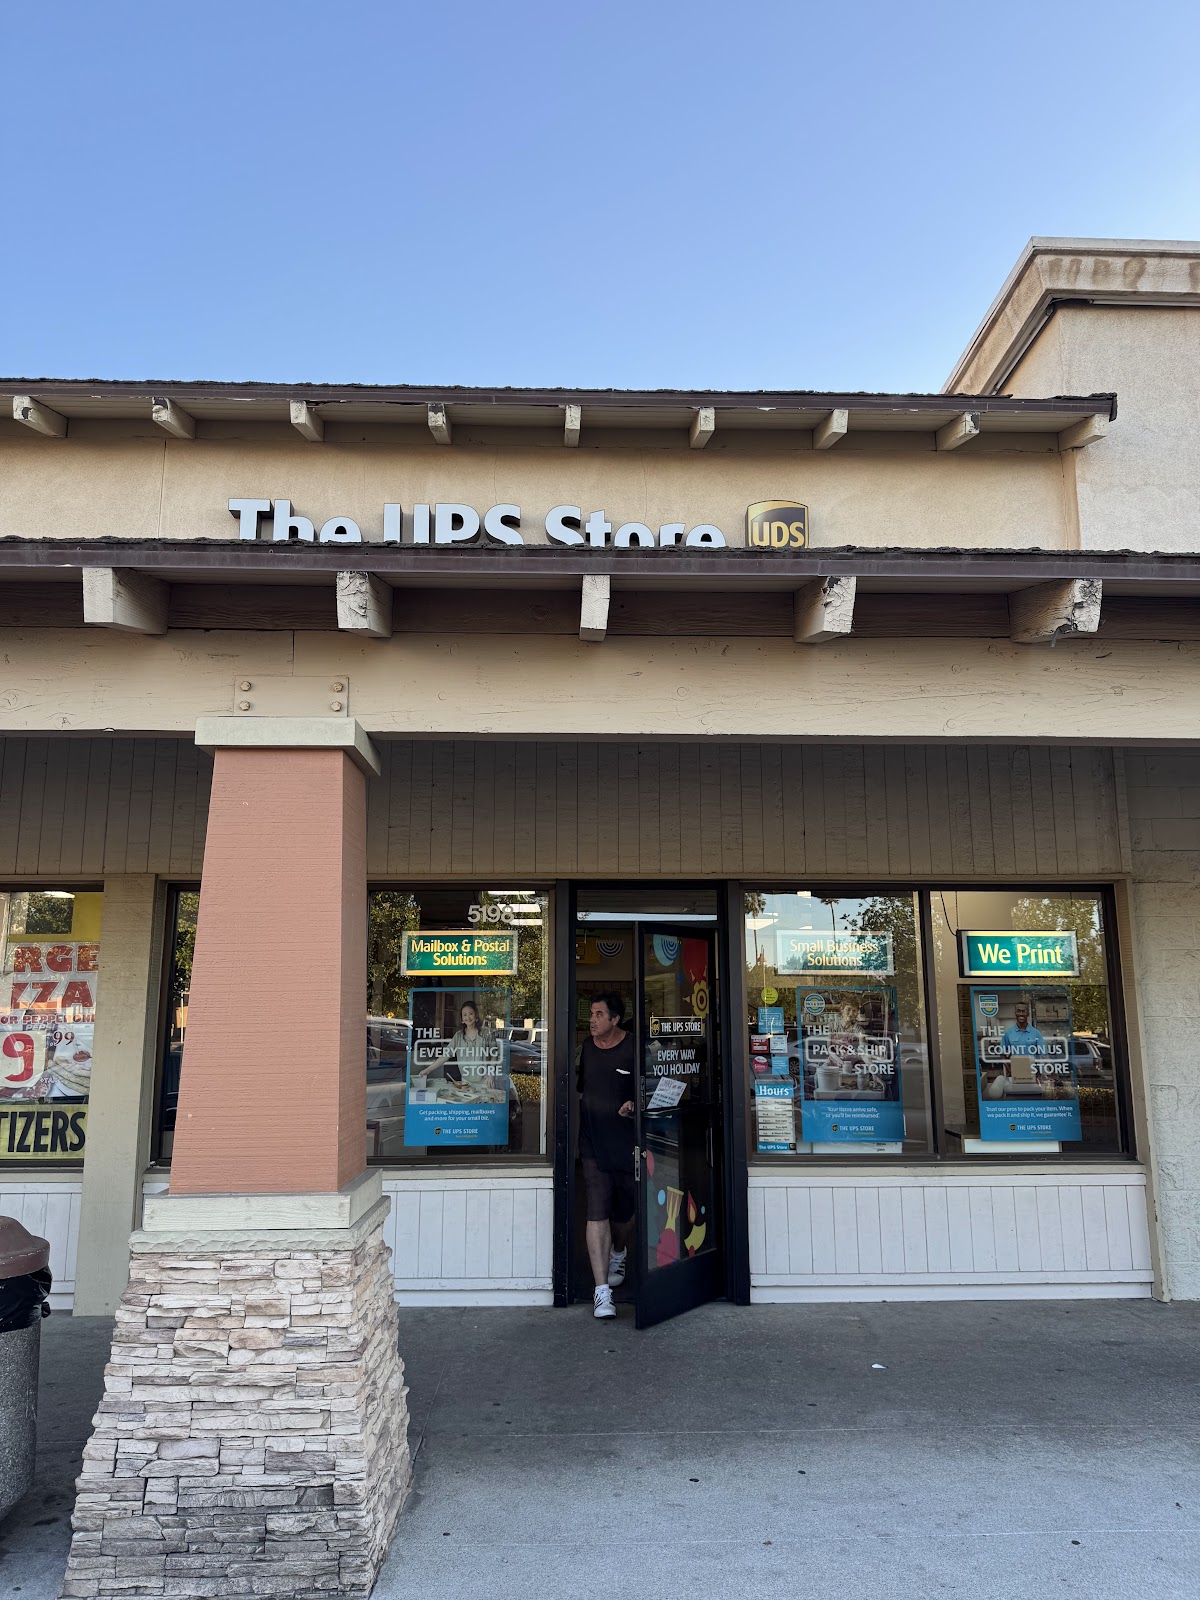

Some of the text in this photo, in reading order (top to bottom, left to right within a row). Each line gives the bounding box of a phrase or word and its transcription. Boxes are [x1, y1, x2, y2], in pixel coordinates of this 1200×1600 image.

[228, 498, 362, 542] The
[545, 504, 726, 548] Store
[467, 904, 515, 923] 5198
[411, 939, 510, 953] Mailbox & Postal
[790, 939, 879, 954] Small Business
[432, 952, 488, 967] Solutions
[806, 952, 864, 967] Solutions
[977, 943, 1064, 965] We Print
[415, 1027, 441, 1039] THE
[661, 1022, 672, 1032] THE
[673, 1021, 684, 1032] UPS
[685, 1021, 701, 1031] STORE
[805, 1024, 830, 1036] THE
[980, 1025, 1005, 1037] THE
[419, 1046, 499, 1058] EVERYTHING
[657, 1048, 696, 1061] EVERY WAY
[812, 1043, 887, 1056] PACK & SHIP
[987, 1044, 1062, 1055] COUNT ON US
[3, 1032, 35, 1083] 9
[462, 1065, 503, 1077] STORE
[653, 1062, 701, 1076] YOU HOLIDAY
[854, 1063, 895, 1075] STORE
[1030, 1063, 1070, 1074] STORE
[759, 1085, 790, 1096] Hours
